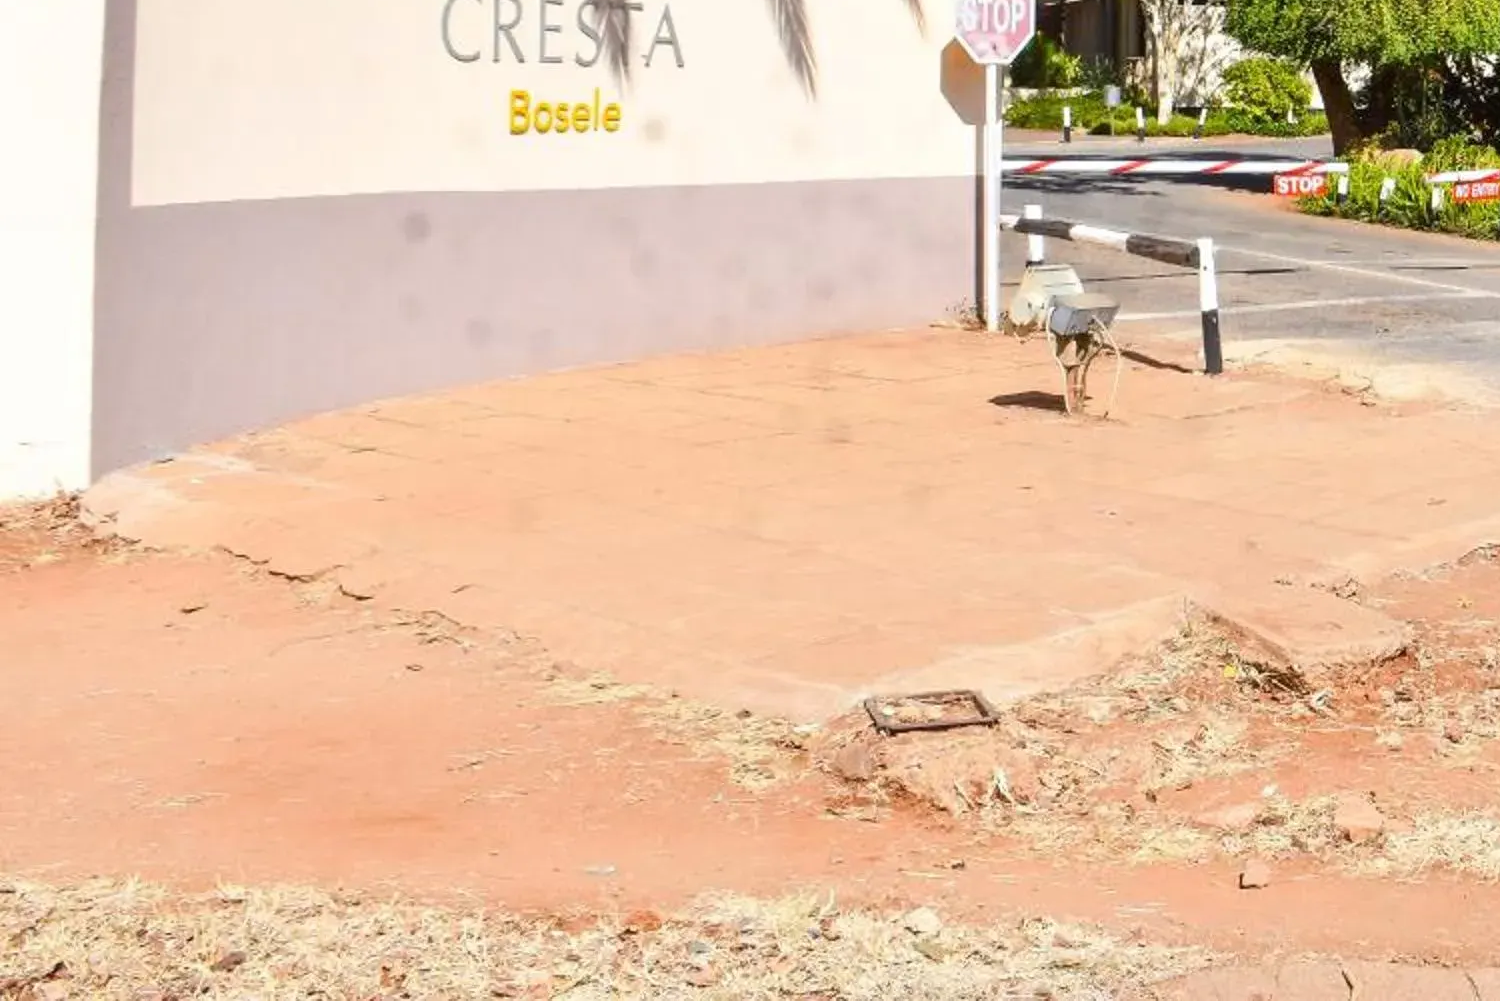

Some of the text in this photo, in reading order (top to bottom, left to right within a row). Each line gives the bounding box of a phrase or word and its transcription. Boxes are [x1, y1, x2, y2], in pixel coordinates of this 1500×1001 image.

[509, 87, 622, 135] Bosele
[1278, 175, 1325, 196] STOP
[1455, 182, 1470, 198] NO
